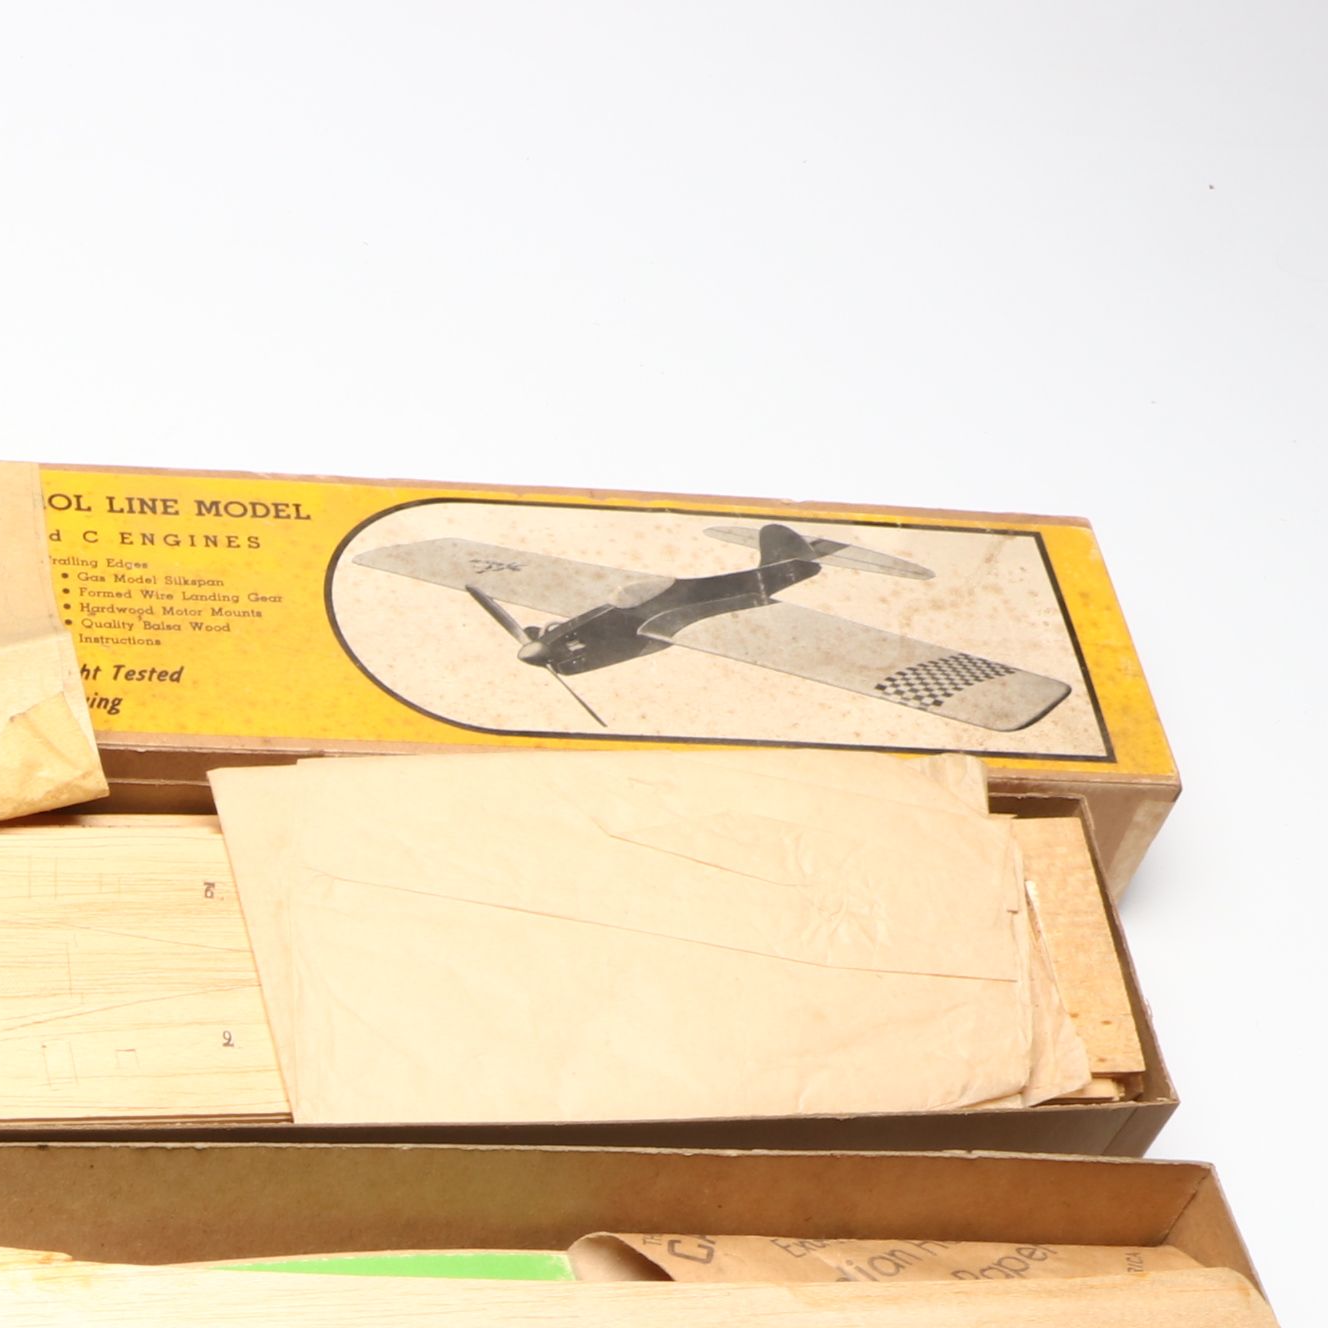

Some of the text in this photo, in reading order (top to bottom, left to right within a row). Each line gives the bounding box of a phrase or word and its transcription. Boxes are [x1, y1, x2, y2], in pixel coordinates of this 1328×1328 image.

[106, 496, 180, 516] LINE
[195, 499, 312, 520] MODEL
[82, 530, 99, 543] C
[119, 532, 261, 549] ENGINES
[48, 556, 148, 571] railing Edges
[77, 572, 224, 588] Gas Model Silkspan
[79, 587, 283, 604] Formed Wire Landing Gear
[80, 603, 262, 618] Hardwood Motor Mounts
[81, 618, 231, 632] Quality Balsa Wood
[79, 634, 161, 646] Instructions
[112, 664, 184, 683] Tested
